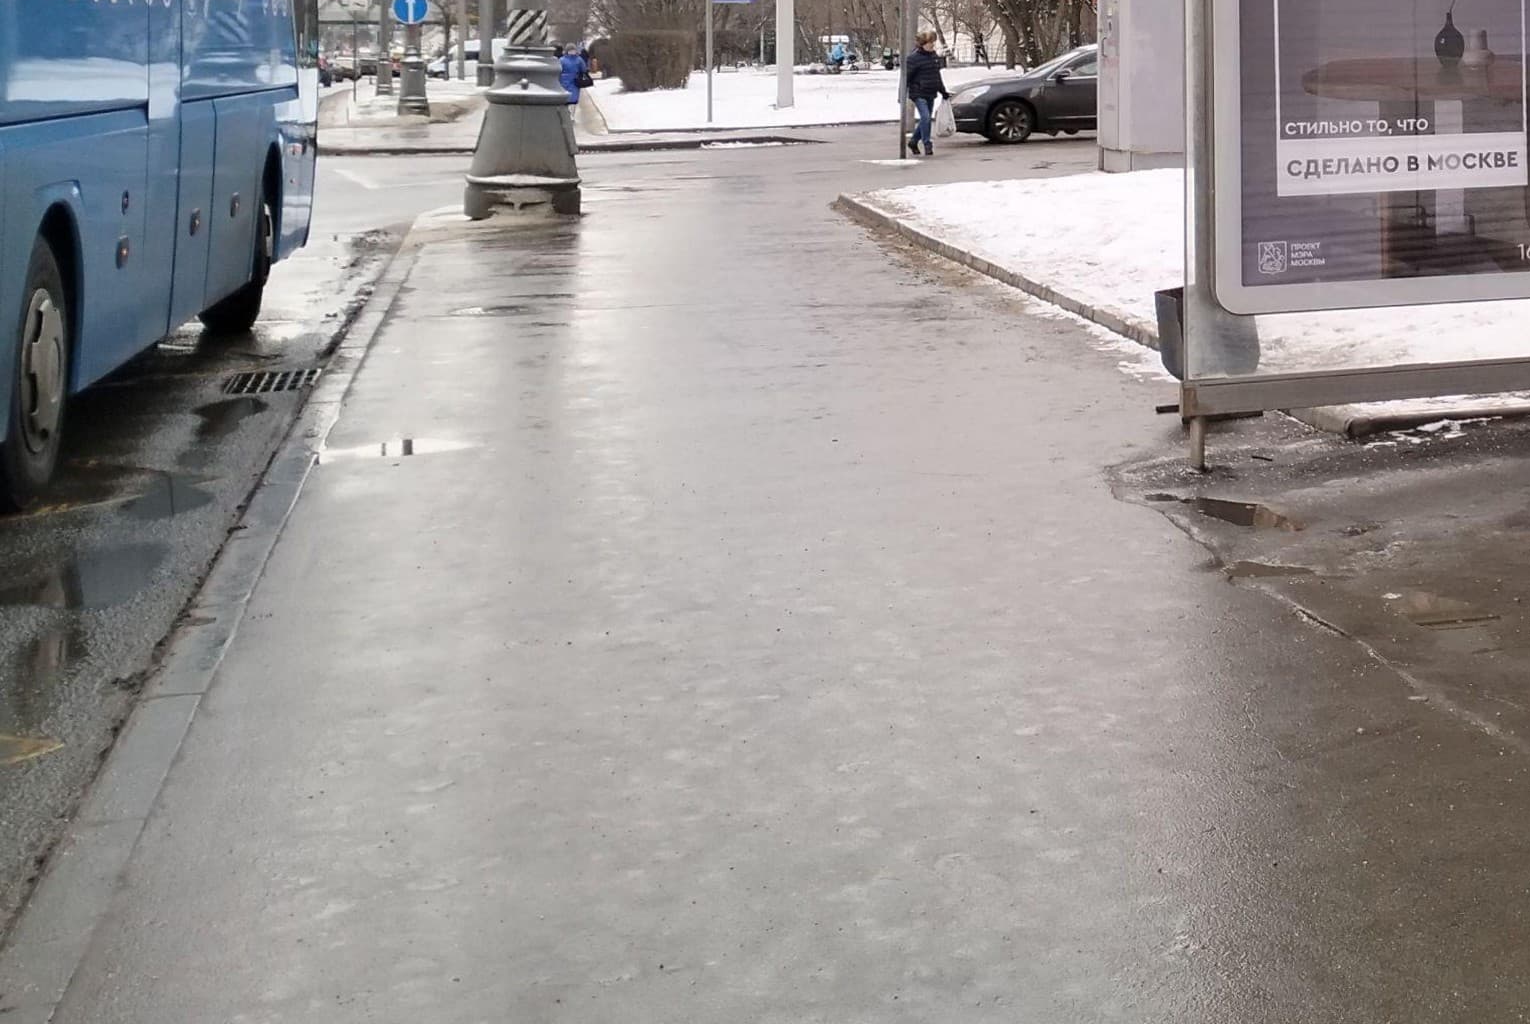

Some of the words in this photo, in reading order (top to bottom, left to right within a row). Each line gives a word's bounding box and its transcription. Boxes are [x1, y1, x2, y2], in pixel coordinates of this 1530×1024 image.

[1284, 120, 1362, 136] СТИЛЬНО
[1366, 119, 1392, 135] ТО,
[1396, 118, 1429, 132] ЧТО
[1286, 156, 1399, 179] СДЕЛАНО
[1407, 155, 1420, 172] В
[1427, 151, 1518, 171] МОСКВЕ
